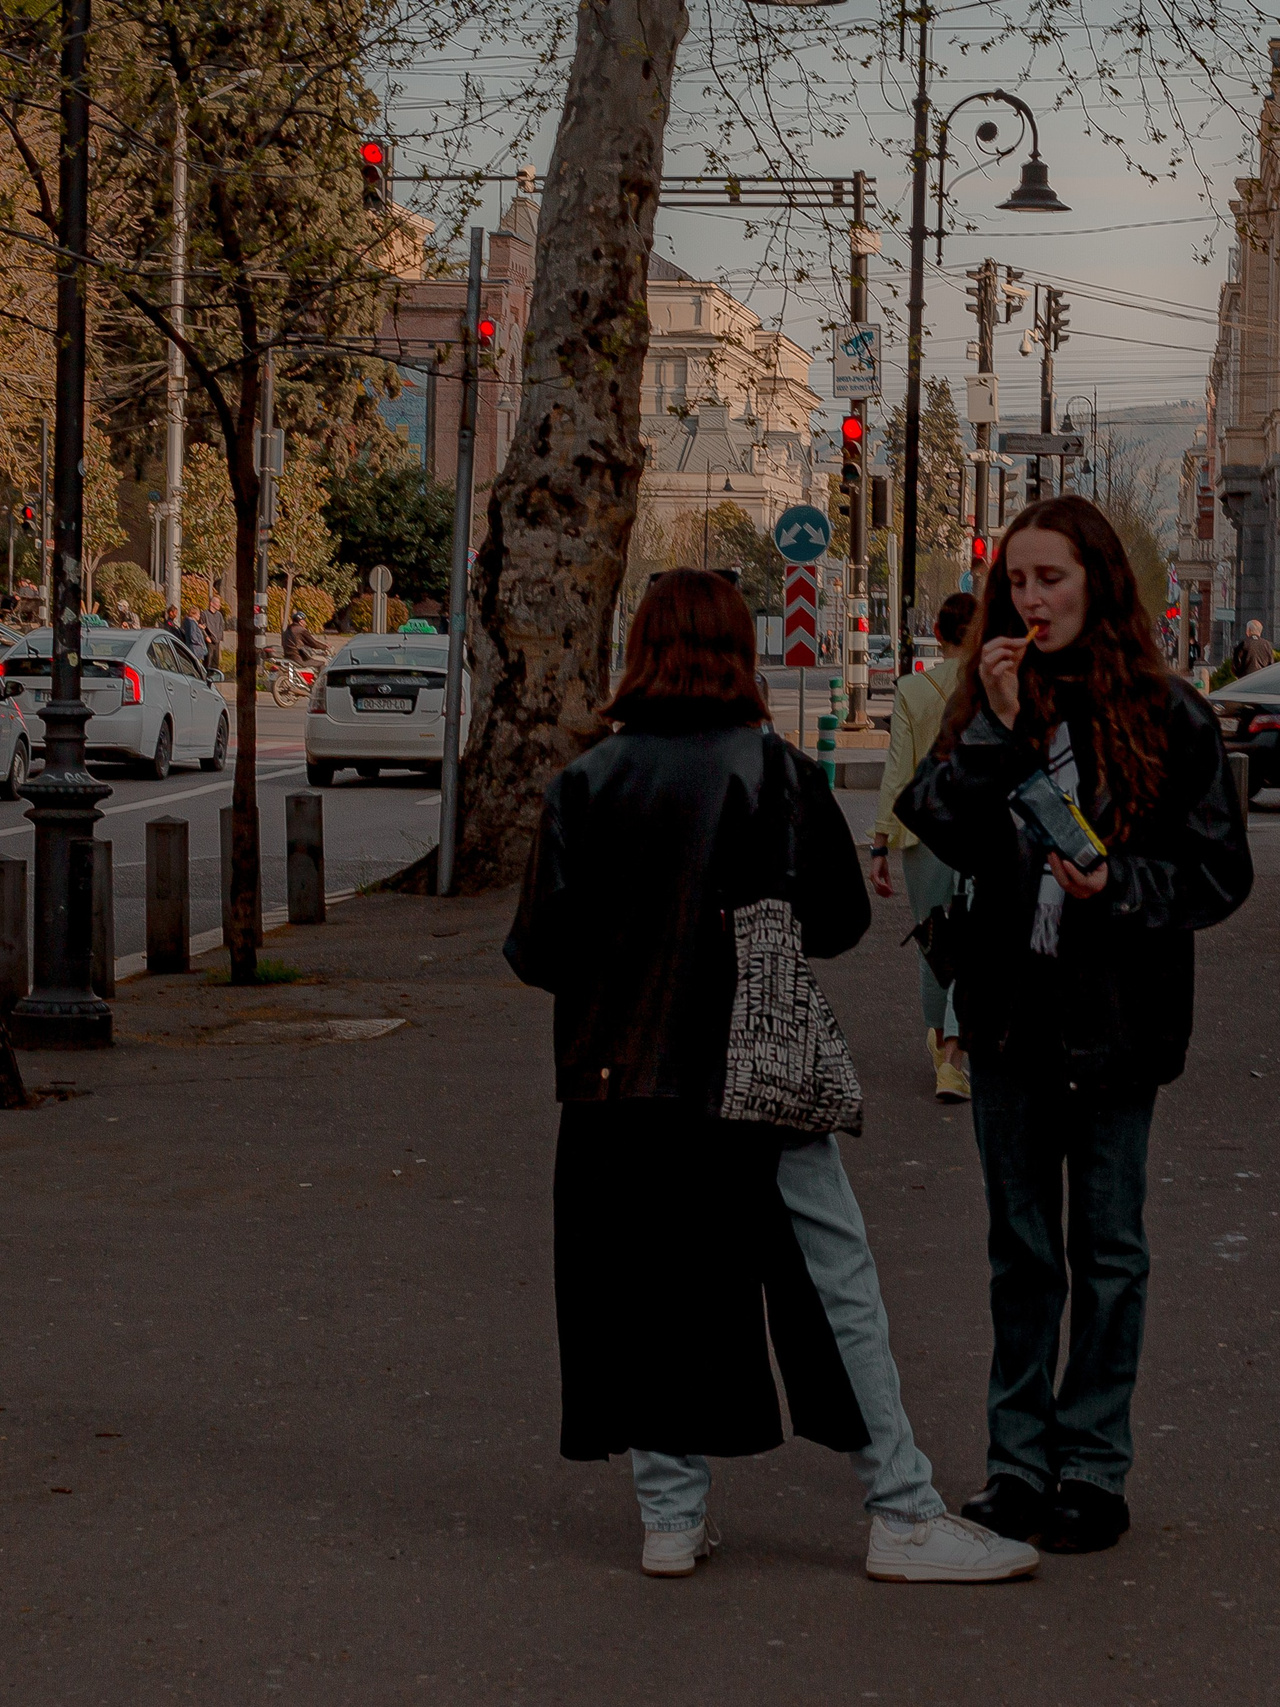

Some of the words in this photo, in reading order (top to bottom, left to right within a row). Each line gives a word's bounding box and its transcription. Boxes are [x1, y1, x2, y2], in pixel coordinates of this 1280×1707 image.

[749, 1015, 798, 1039] PARIS
[755, 1041, 789, 1063] NEW
[755, 1058, 789, 1080] YORK
[729, 1059, 754, 1120] BEIJING
